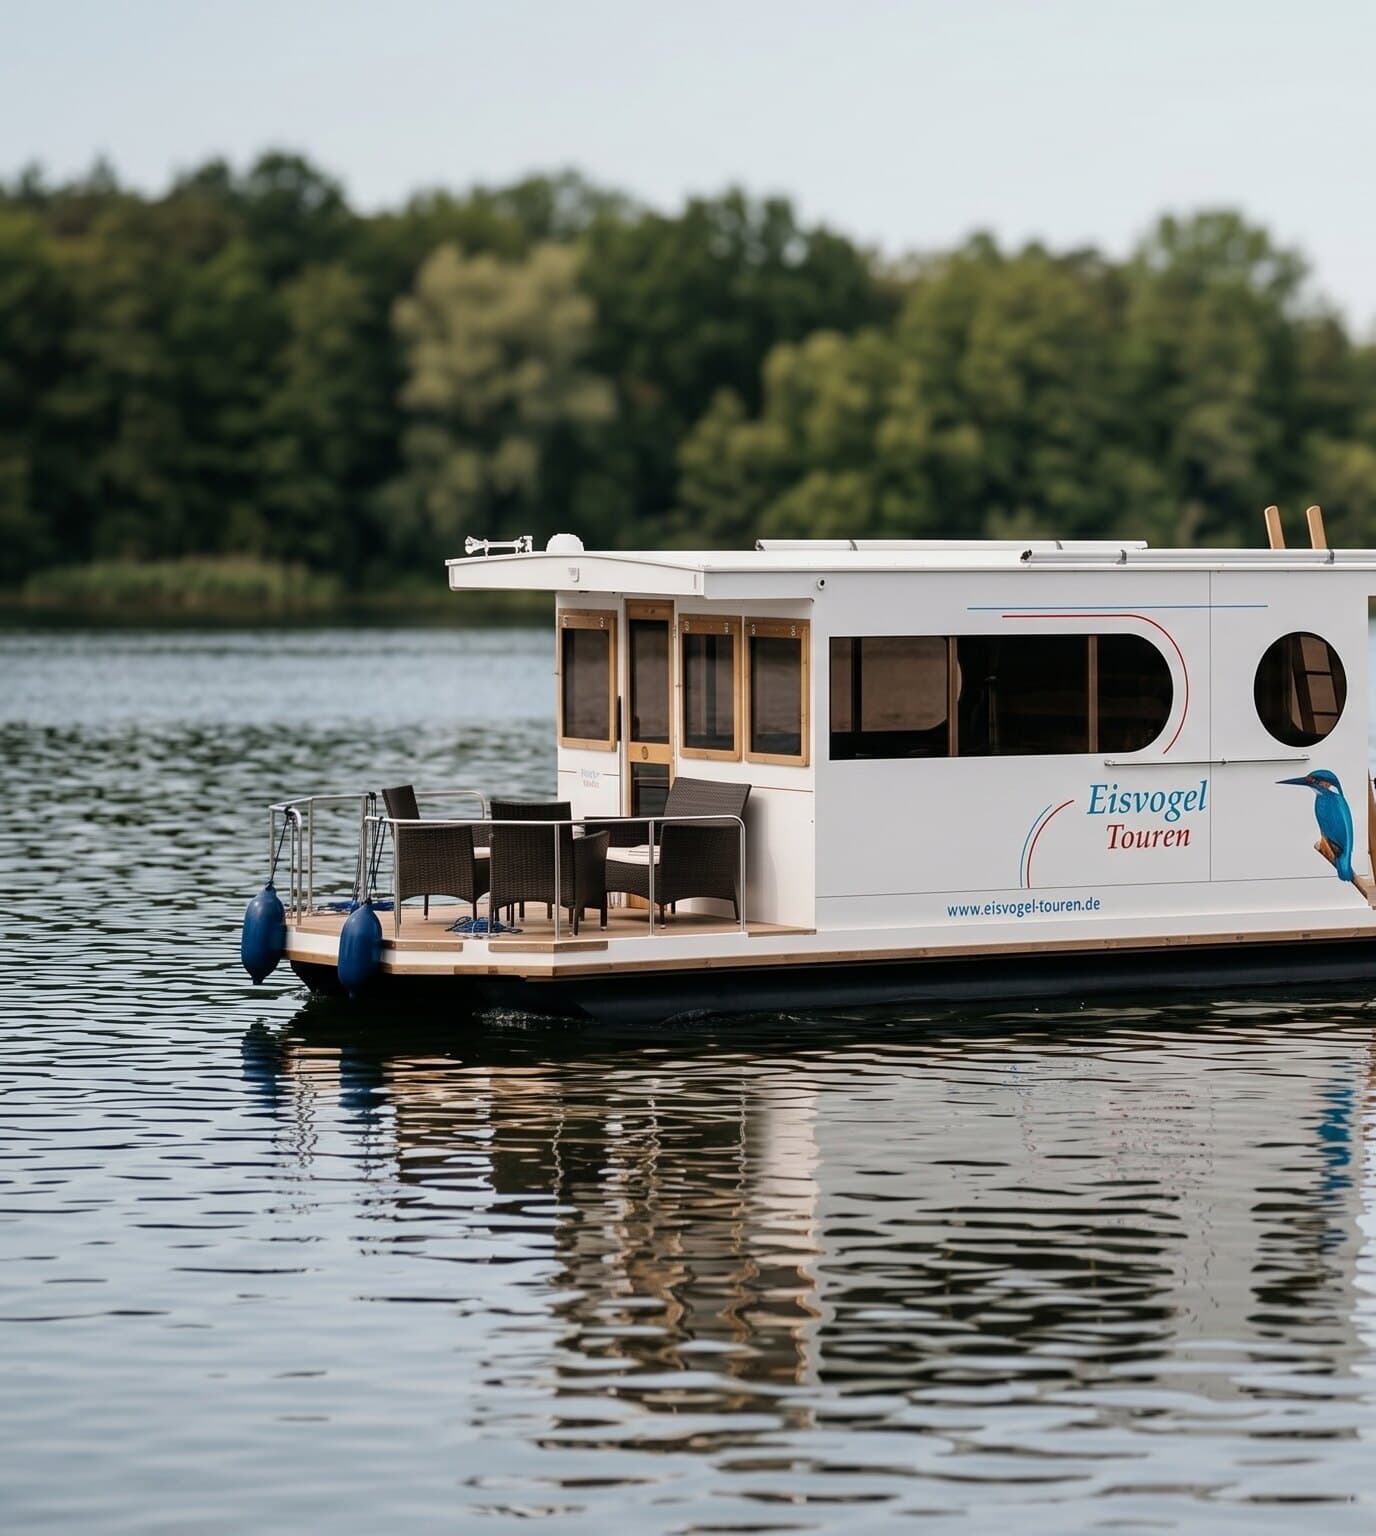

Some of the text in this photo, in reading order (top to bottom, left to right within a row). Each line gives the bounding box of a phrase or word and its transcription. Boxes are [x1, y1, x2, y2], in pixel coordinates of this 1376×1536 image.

[1086, 779, 1208, 822] Eisvogel
[1106, 824, 1190, 849] Touren
[947, 897, 1100, 917] www.eisvogel-touren.de
